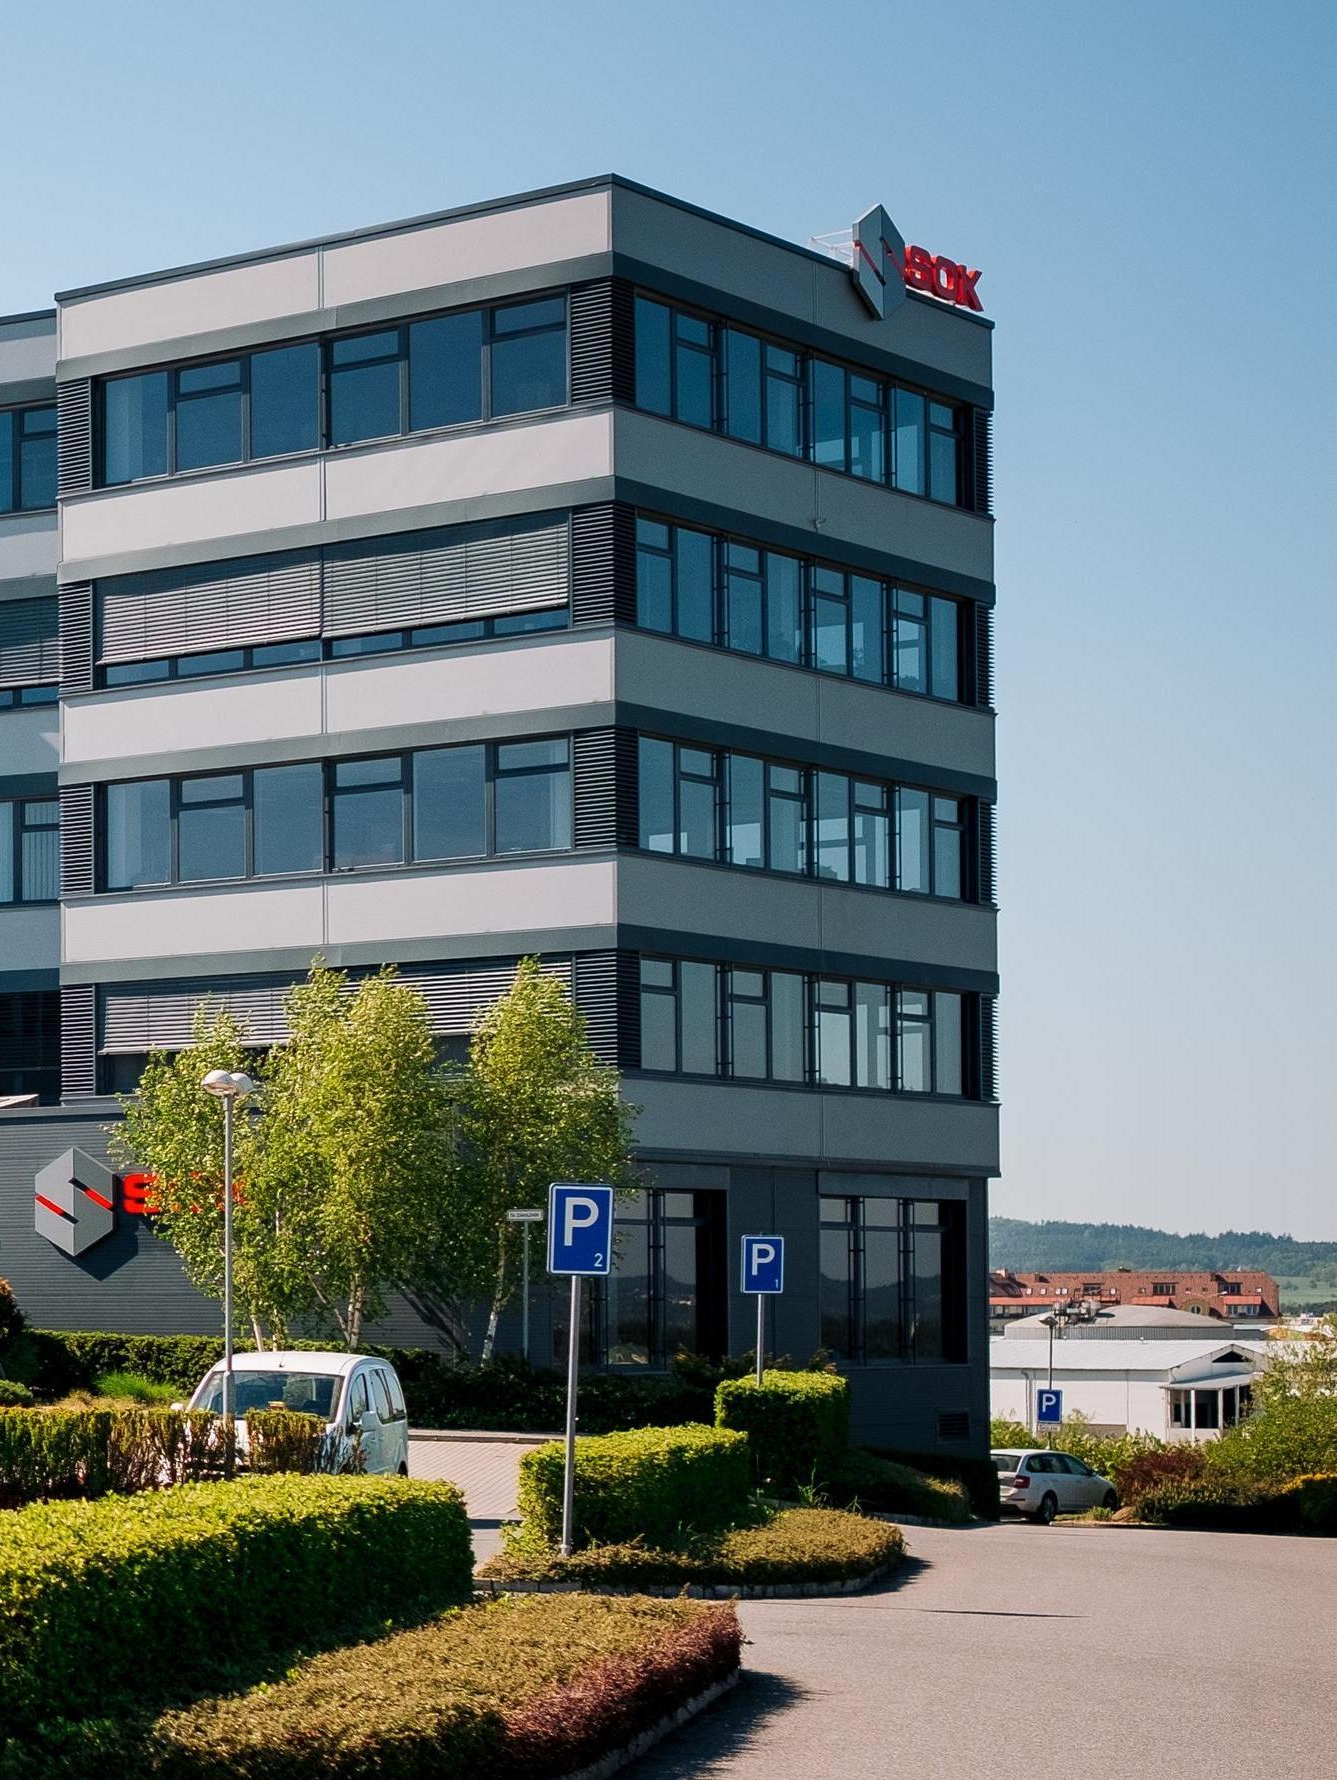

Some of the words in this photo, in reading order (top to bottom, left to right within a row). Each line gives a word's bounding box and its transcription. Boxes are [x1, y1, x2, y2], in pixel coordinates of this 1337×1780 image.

[564, 1196, 599, 1247] P
[593, 1252, 603, 1267] 2
[751, 1243, 776, 1276] P
[774, 1278, 779, 1289] 1
[1042, 1393, 1057, 1413] P
